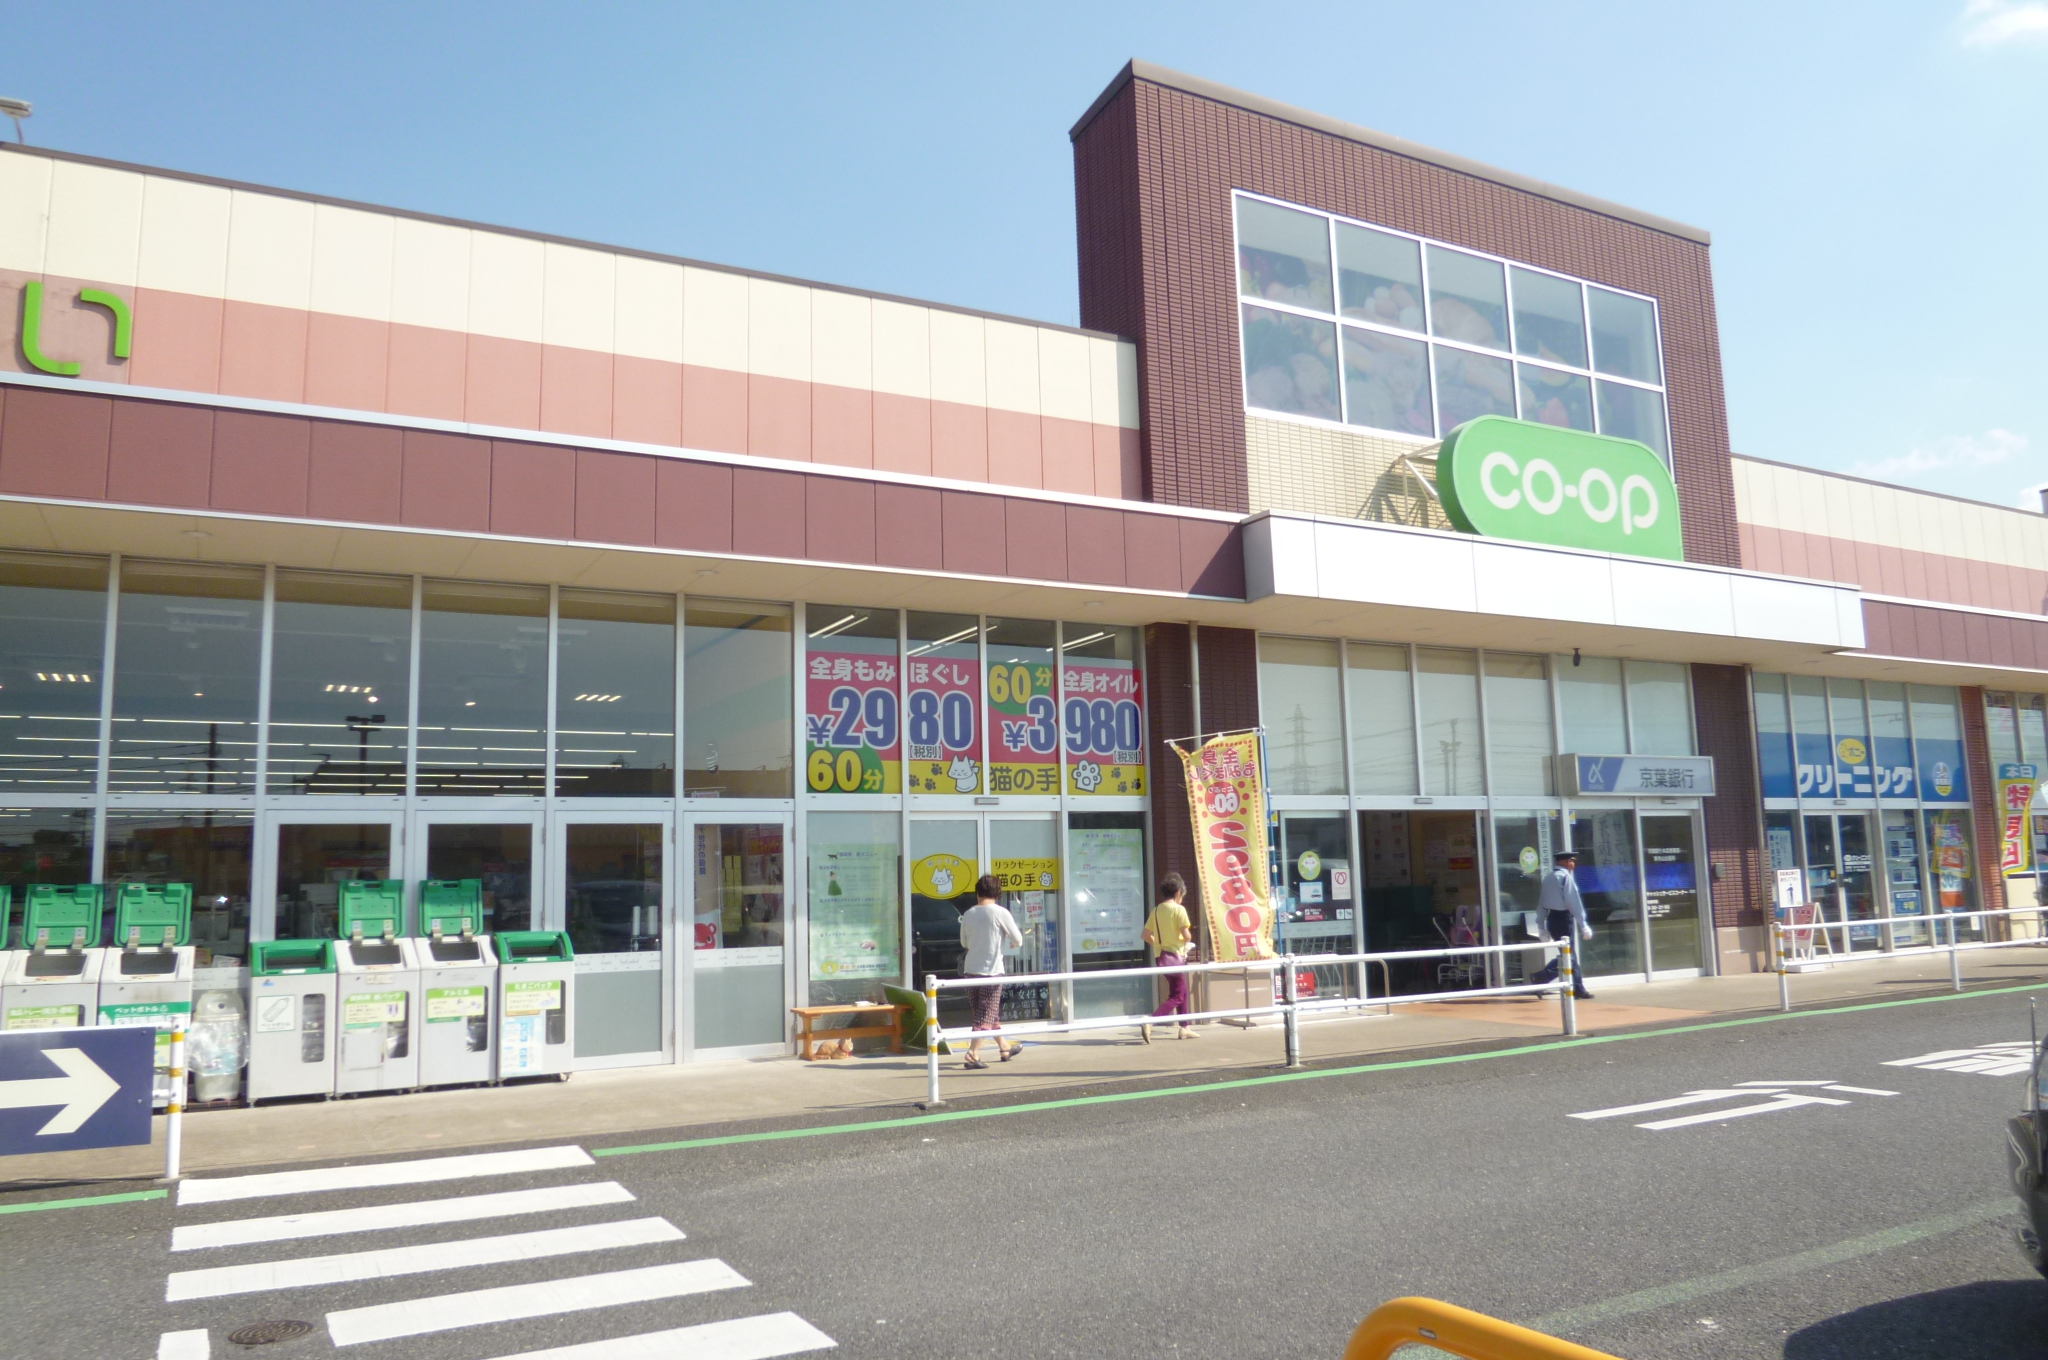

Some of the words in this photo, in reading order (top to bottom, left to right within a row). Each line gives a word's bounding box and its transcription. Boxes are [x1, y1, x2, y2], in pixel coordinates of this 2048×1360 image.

[1063, 671, 1138, 694] 全身オイル
[807, 750, 883, 793] 60分
[990, 767, 1058, 792] 猫の手
[1639, 768, 1694, 788] 京葉銀行
[2006, 766, 2032, 778] 本日
[995, 860, 1054, 870] リラクゼーション
[514, 982, 553, 990] たまごパック
